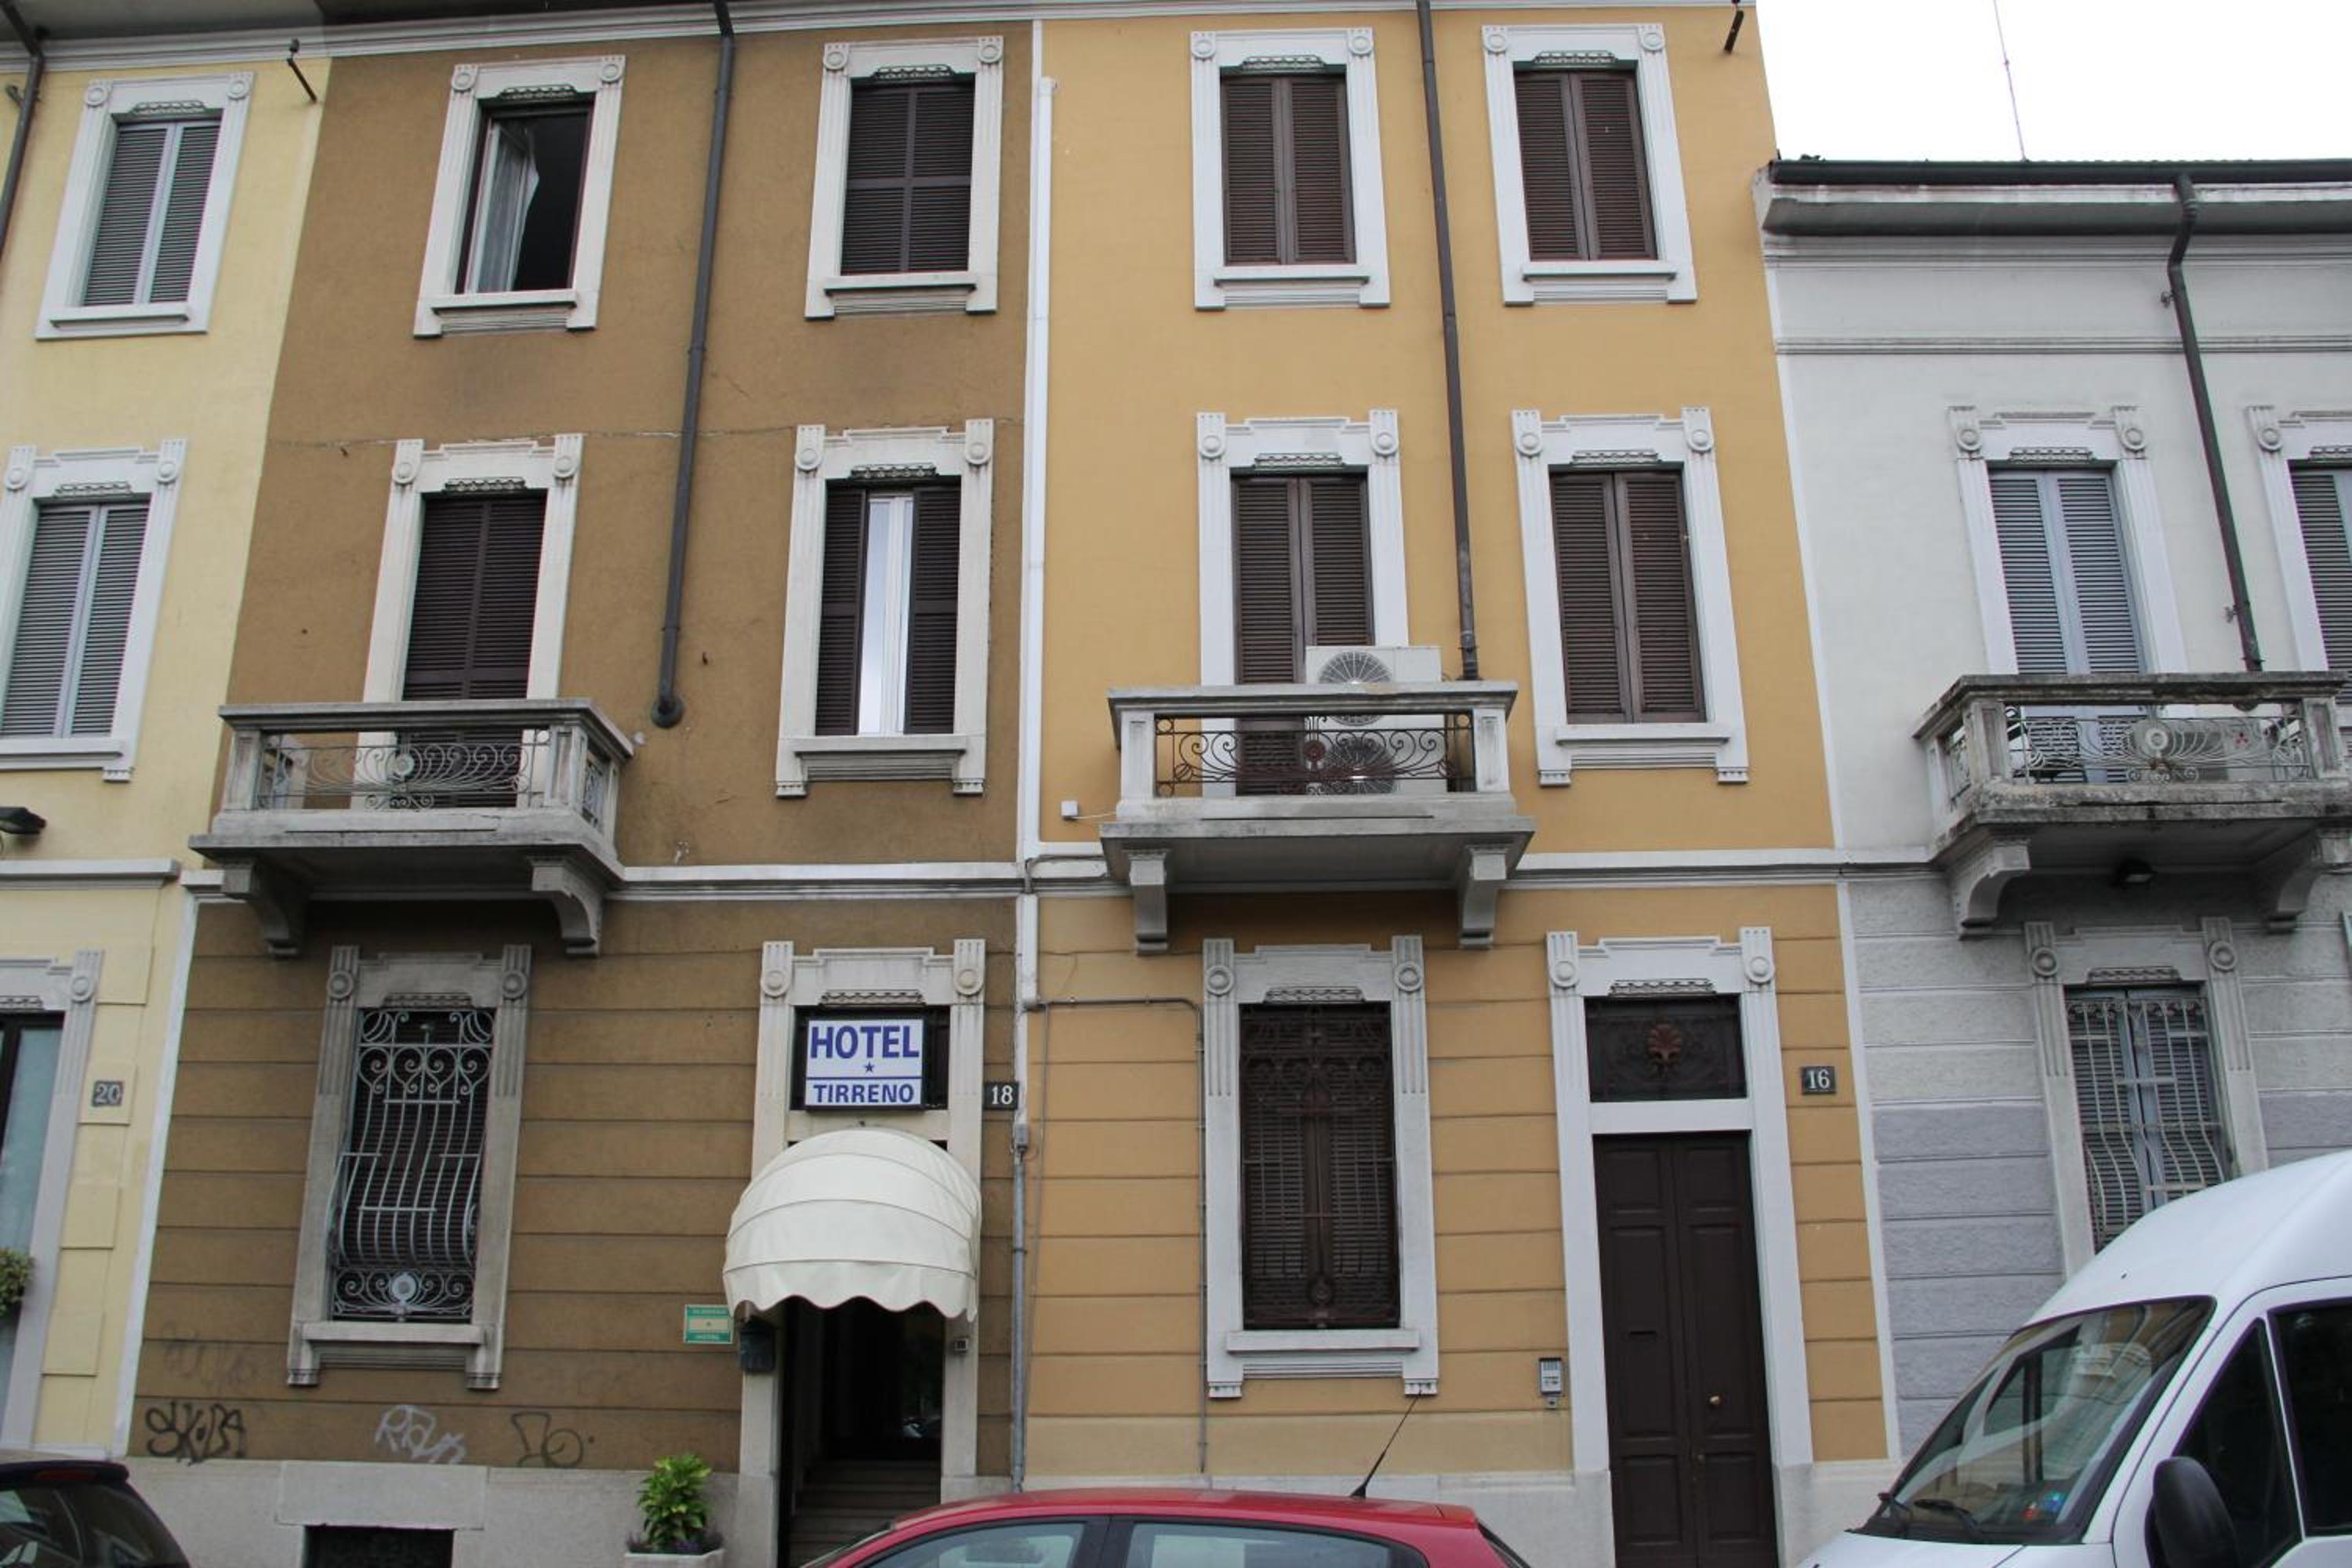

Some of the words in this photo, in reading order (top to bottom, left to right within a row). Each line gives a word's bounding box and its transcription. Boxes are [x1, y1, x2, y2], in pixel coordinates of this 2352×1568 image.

[810, 1025, 920, 1059] HOTEL
[1808, 1069, 1831, 1089] 16
[95, 1083, 121, 1104] 20
[813, 1083, 915, 1104] TIRRENO
[991, 1084, 1014, 1105] 18
